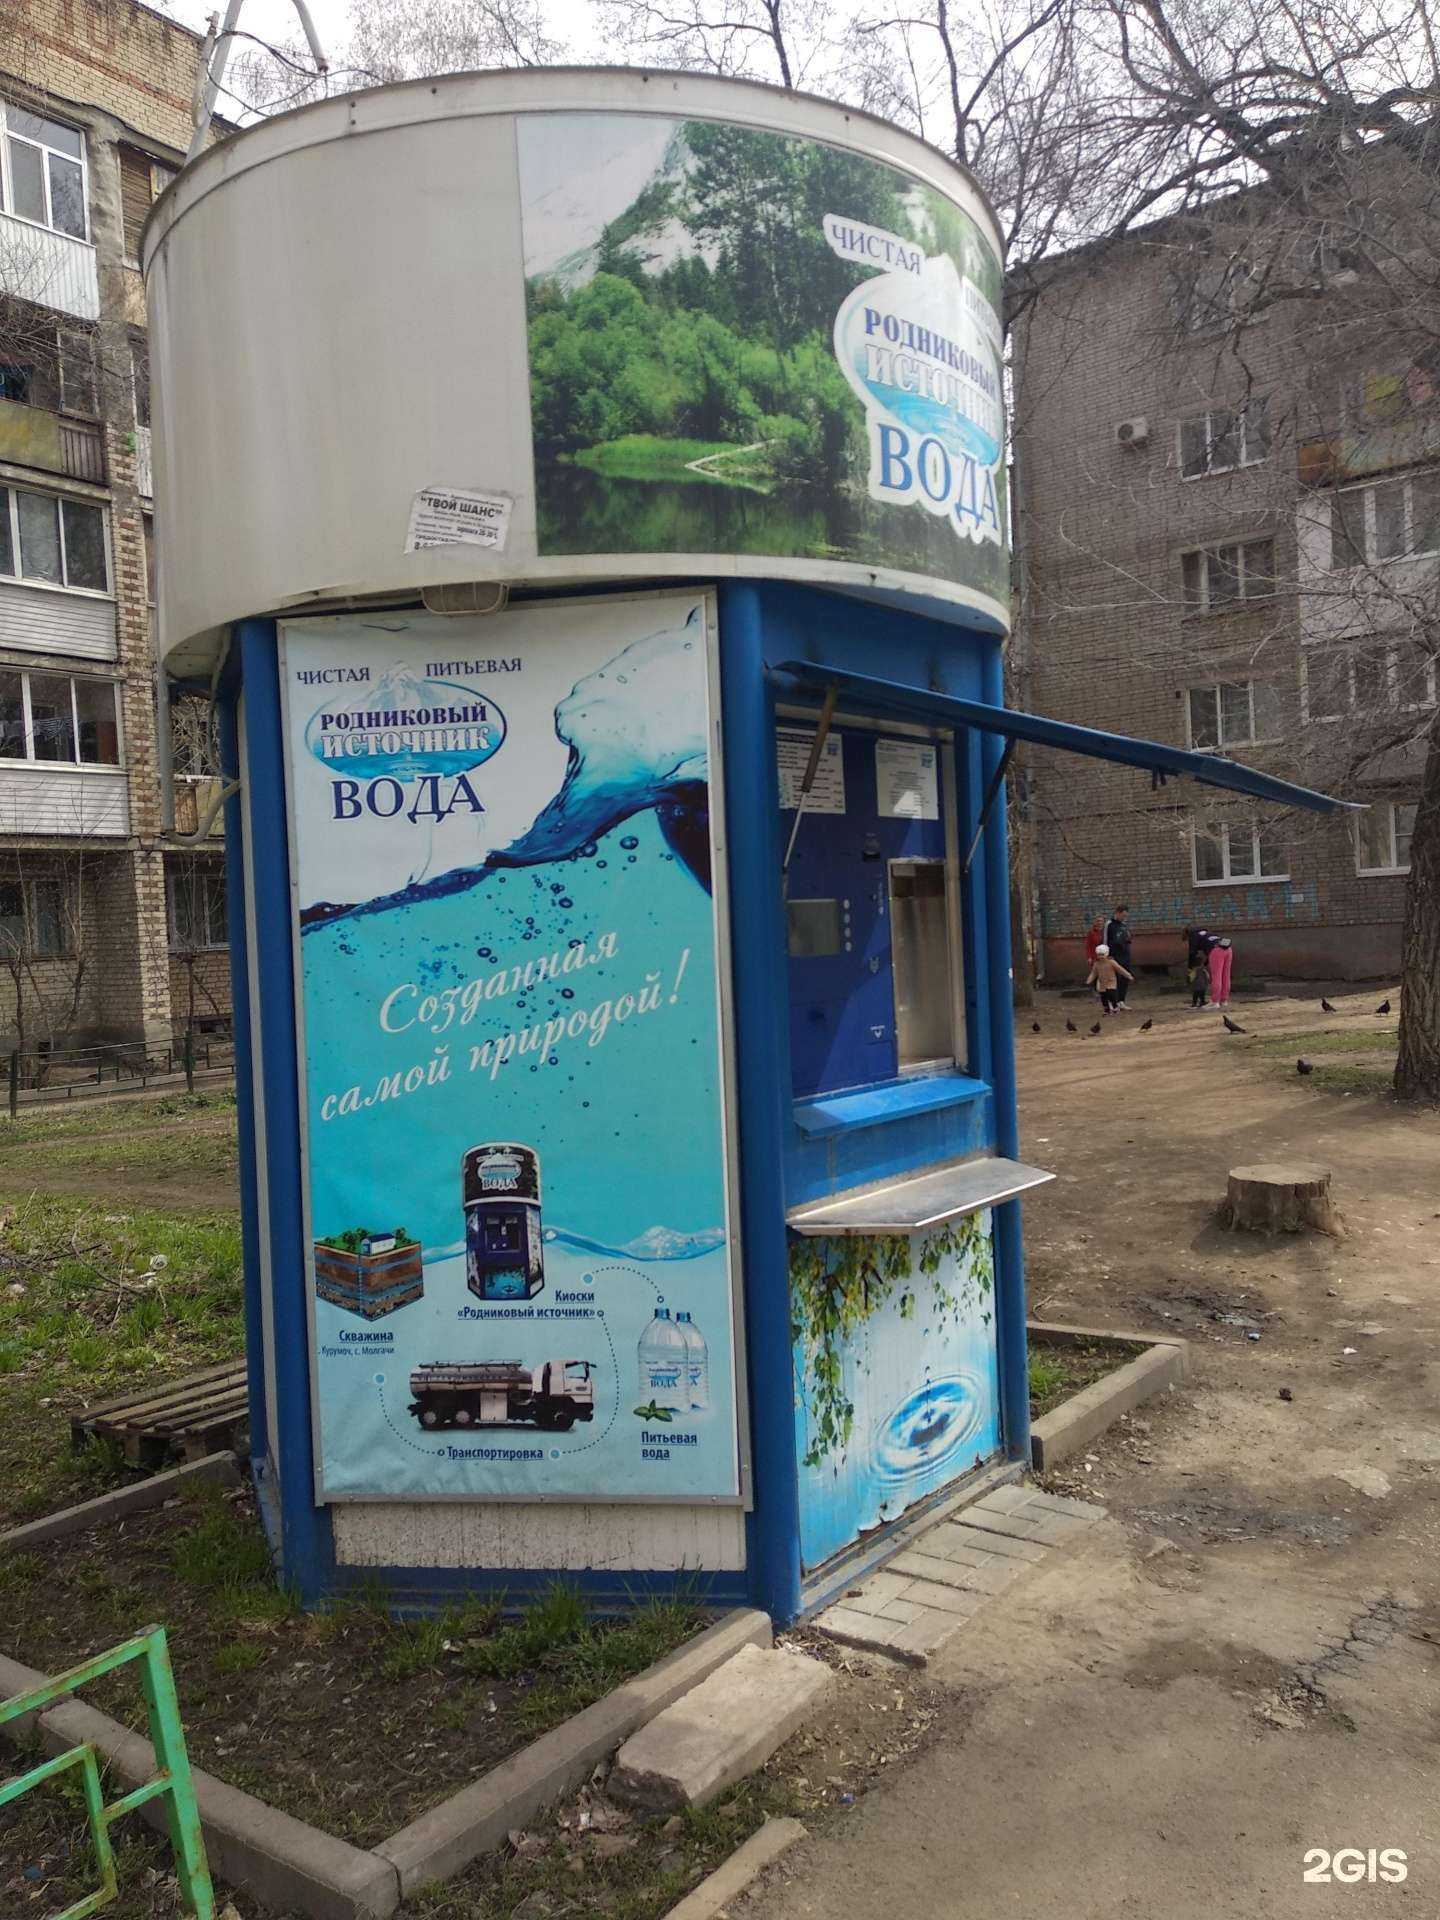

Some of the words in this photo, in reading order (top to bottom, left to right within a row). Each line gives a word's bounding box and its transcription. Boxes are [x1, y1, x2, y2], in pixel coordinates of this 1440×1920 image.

[831, 223, 922, 276] ЧИСТАЯ
[865, 344, 998, 440] ИСТОЧНИ
[877, 423, 998, 530] ВОДА
[297, 668, 370, 684] ЧИСТАЯ
[426, 658, 522, 676] ПИТЬЕВАЯ
[321, 702, 487, 731] РОДНИКОВЫЙ
[321, 727, 490, 758] ИСТОЧНИК
[331, 774, 485, 824] ВОДА
[379, 931, 619, 1034] Созданная
[320, 1044, 452, 1121] самой
[556, 1290, 594, 1301] Киоски
[458, 1306, 533, 1319] «Родниковый
[537, 1310, 595, 1318] источник»
[339, 1330, 394, 1341] Скважина
[447, 1446, 544, 1459] Транспортировка
[641, 1432, 697, 1444] Питьевая
[642, 1448, 671, 1459] вода
